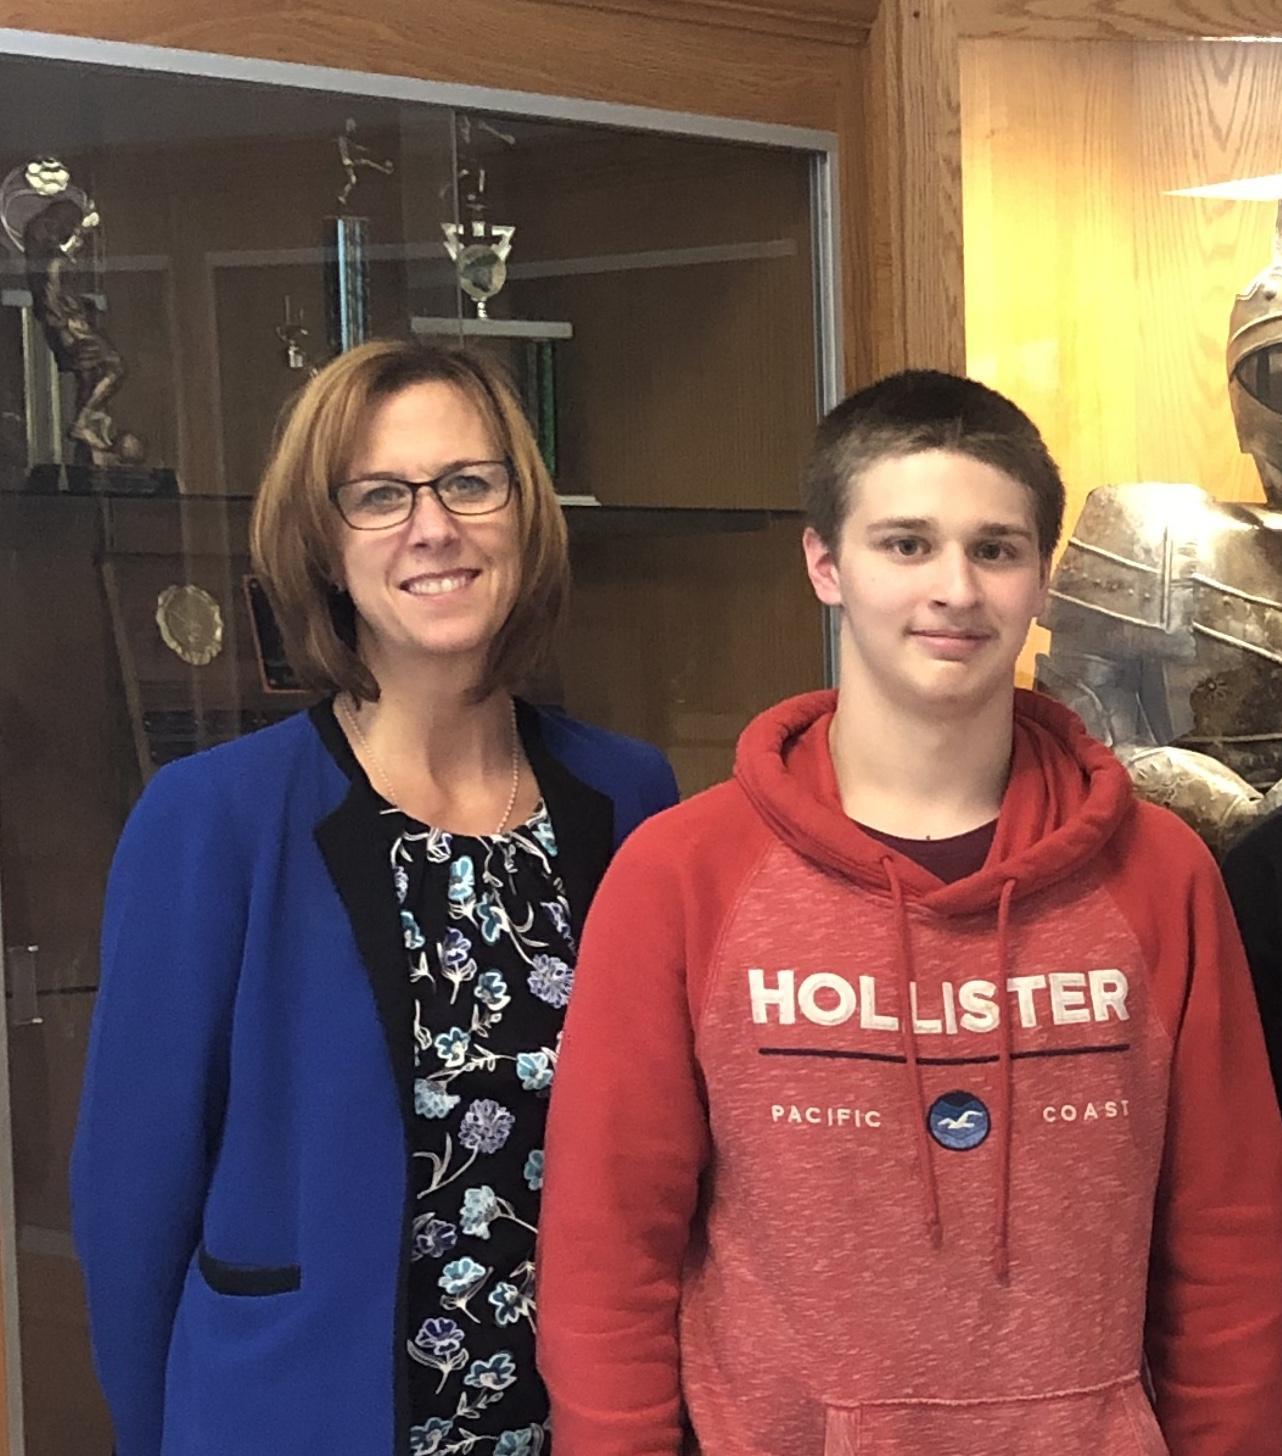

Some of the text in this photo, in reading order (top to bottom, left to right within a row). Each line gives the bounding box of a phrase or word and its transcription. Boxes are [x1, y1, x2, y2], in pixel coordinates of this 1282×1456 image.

[747, 968, 1131, 1035] HOLLISTER
[771, 1100, 1130, 1128] PACIFIC COAST
